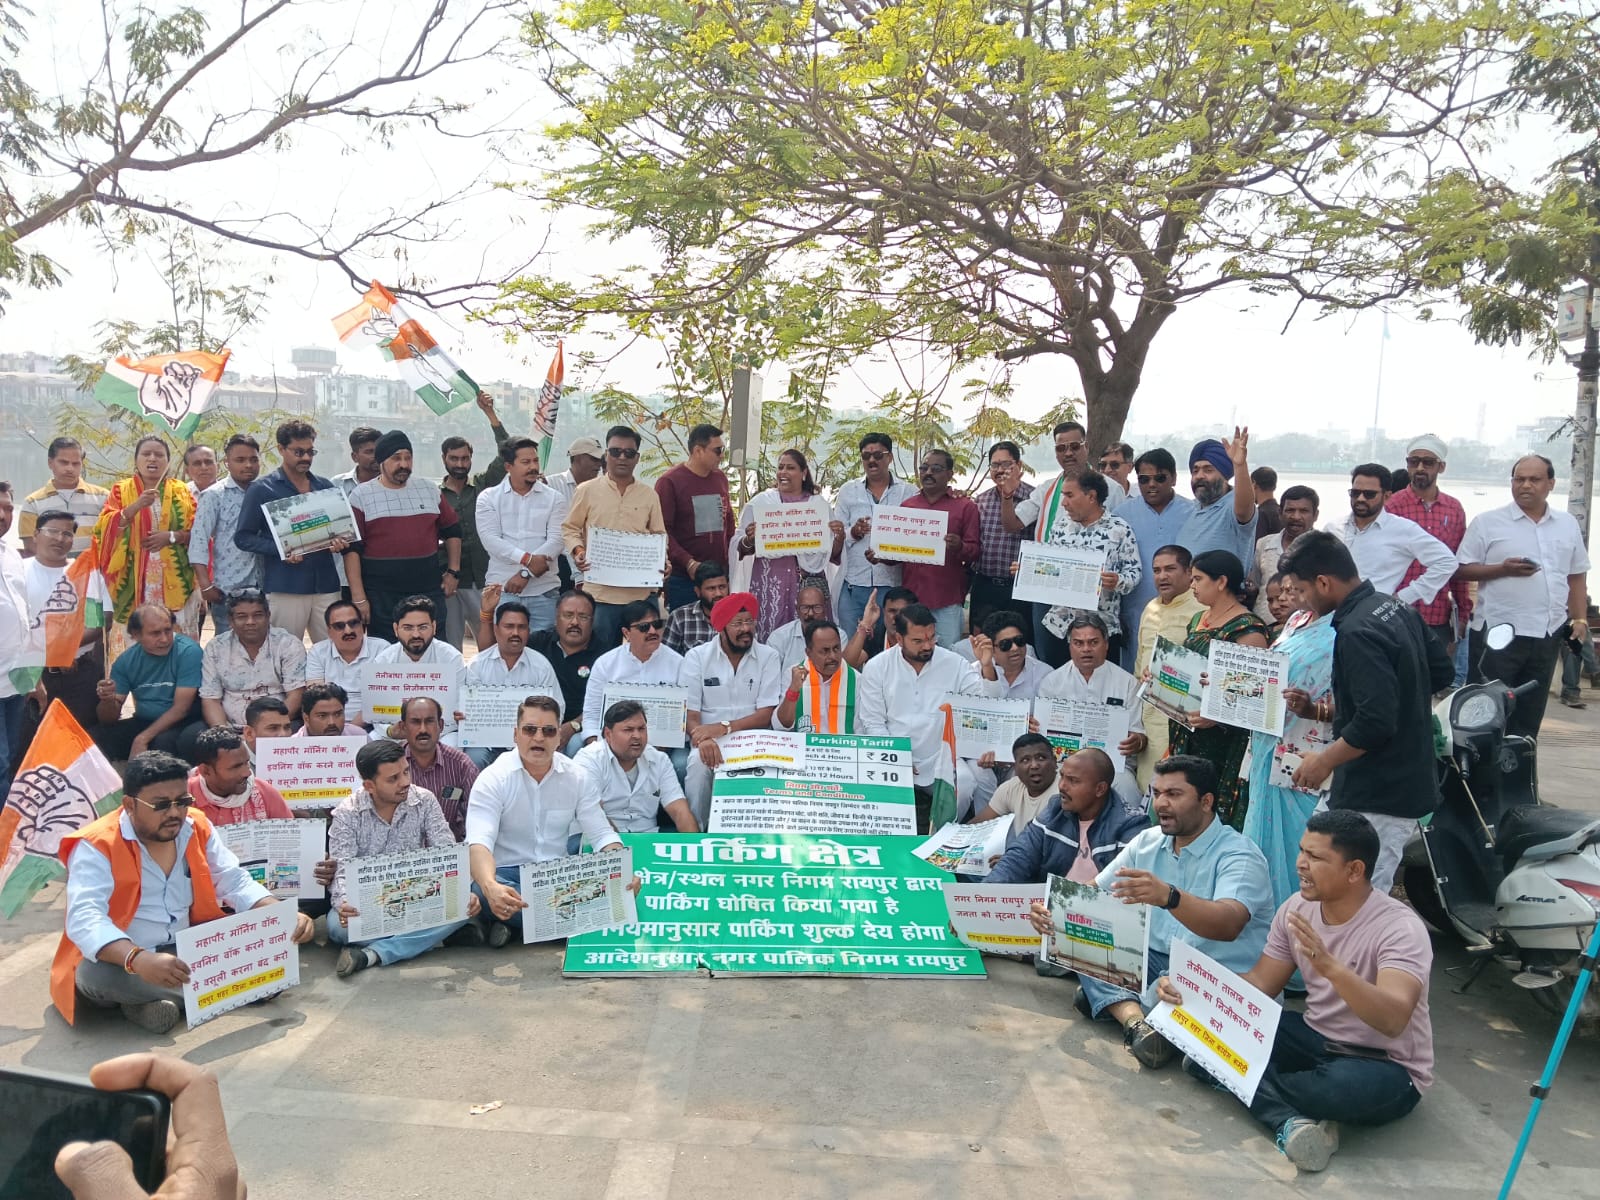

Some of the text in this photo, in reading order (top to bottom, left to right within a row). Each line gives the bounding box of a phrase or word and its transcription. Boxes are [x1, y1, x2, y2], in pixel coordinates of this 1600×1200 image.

[272, 746, 299, 756] महापौर
[811, 737, 857, 746] Parking
[866, 752, 898, 762] ₹ 20
[867, 771, 898, 782] ₹ 10
[764, 787, 793, 795] Terms
[815, 792, 865, 800] Conditions
[809, 839, 882, 865] क्षेत्र
[732, 874, 775, 888] नगर
[781, 871, 834, 889] निगम
[840, 875, 898, 894] रायपुर
[904, 877, 943, 891] द्वारा
[644, 891, 900, 915] पार्किंग घोषित किया गया है
[975, 894, 996, 903] निगम
[1001, 897, 1024, 907] रायपुर
[956, 910, 977, 918] जनता
[981, 910, 991, 918] को
[995, 912, 1015, 921] लूटना
[195, 932, 225, 949] महापौर
[262, 916, 281, 928] वॉक,
[727, 919, 794, 938] पार्किंग
[801, 923, 855, 943] शुल्क
[861, 920, 893, 939] देय
[899, 921, 946, 941] होगा
[224, 946, 240, 959] वॉक
[245, 939, 264, 952] करने
[711, 952, 758, 965] नगर
[762, 950, 835, 966] पालिक
[840, 951, 899, 967] निगम
[905, 955, 967, 971] रायपुर
[192, 951, 288, 991] से वसूली करना बंद करो
[1186, 960, 1219, 986] तेलीबांधा
[1221, 983, 1244, 1004] तालाब
[198, 994, 214, 1006] रायपुर
[1176, 973, 1265, 1044] तालाब का निजीकरण बंद
[1171, 1008, 1189, 1026] रायपुर
[1209, 1017, 1223, 1033] करो
